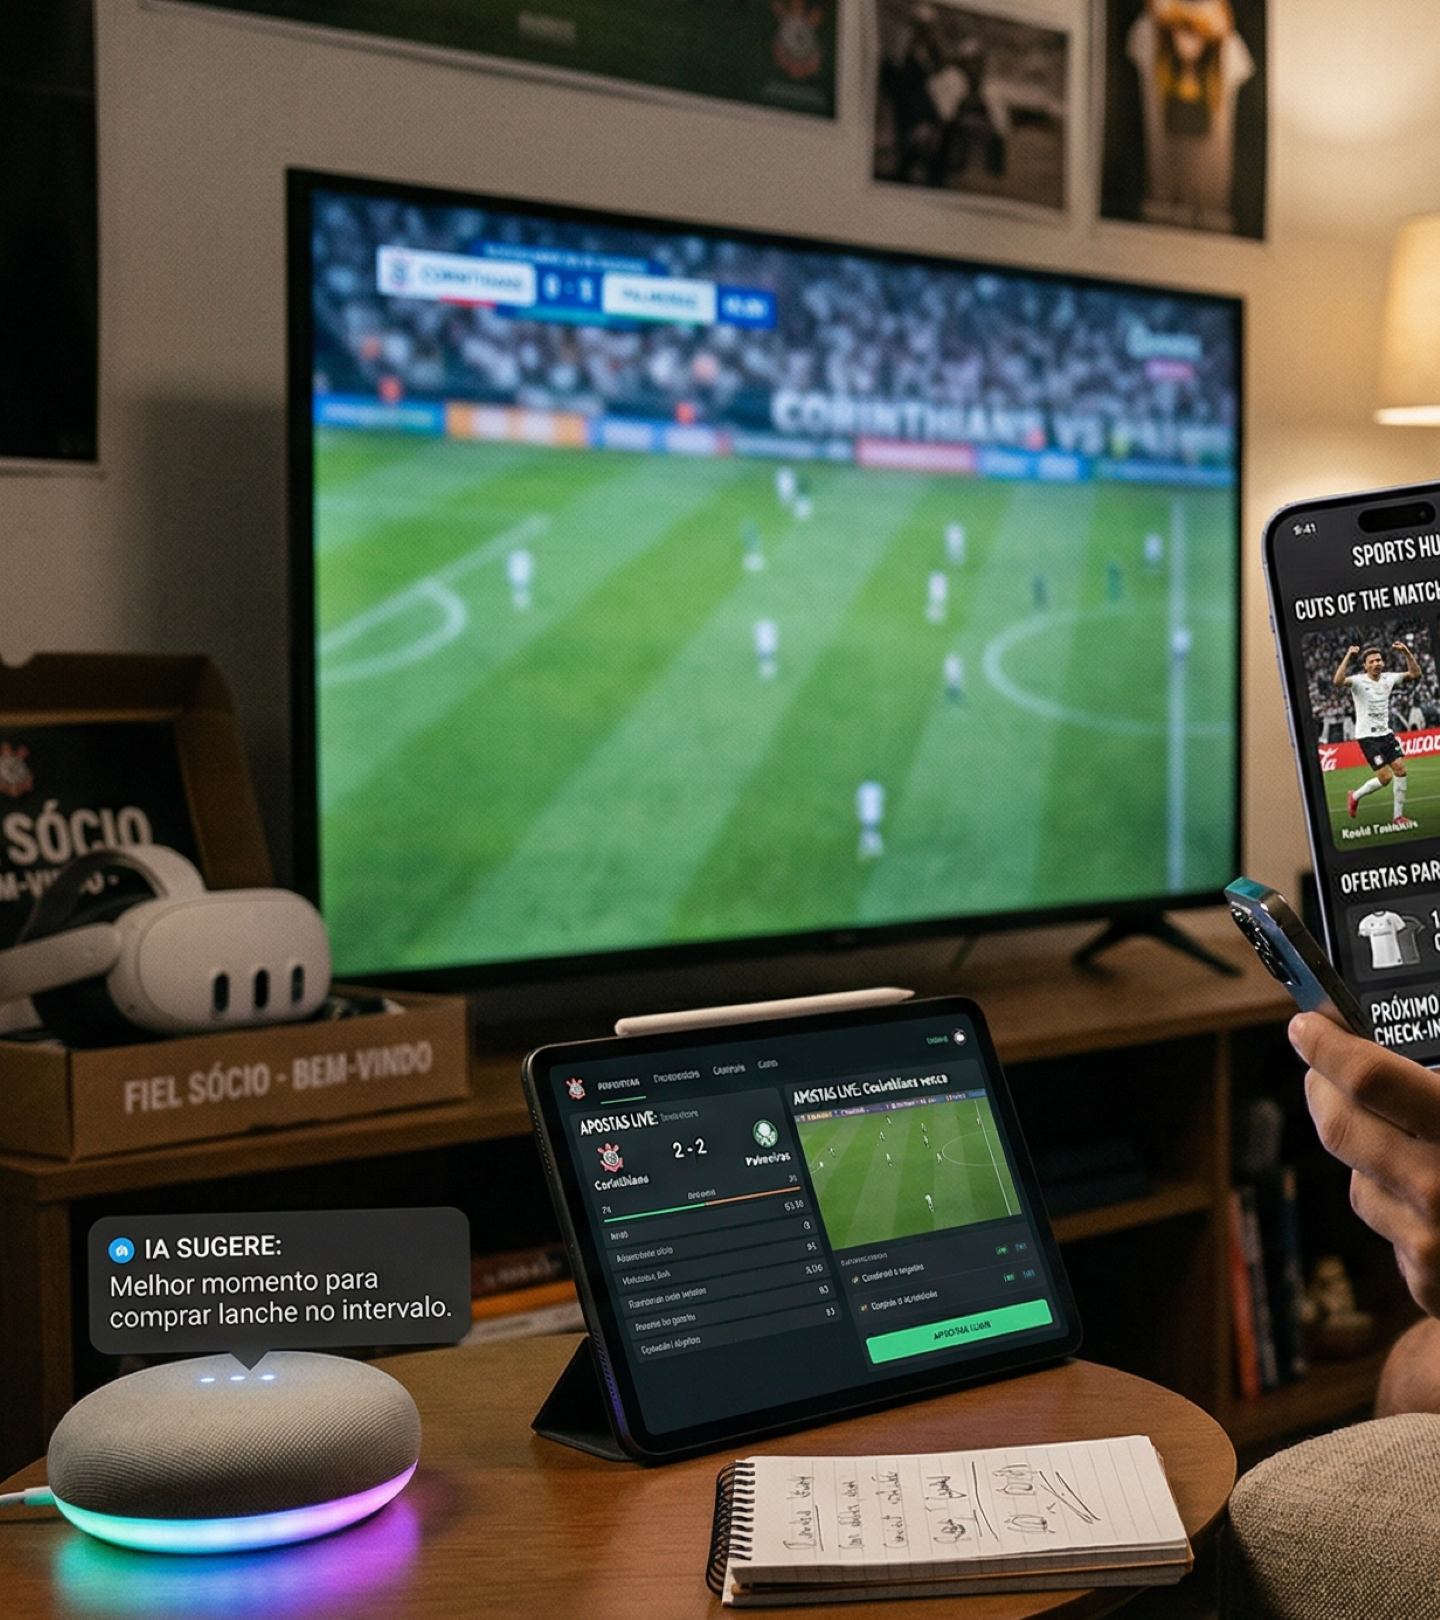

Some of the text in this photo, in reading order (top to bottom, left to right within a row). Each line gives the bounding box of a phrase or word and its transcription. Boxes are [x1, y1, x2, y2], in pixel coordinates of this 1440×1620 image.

[1351, 537, 1417, 568] SPORTS
[1295, 595, 1336, 621] CUTS
[1337, 591, 1357, 615] OF
[1359, 586, 1390, 611] THE
[1340, 864, 1409, 895] OFERTAS
[1370, 994, 1440, 1025] PRÓXIMO
[123, 1074, 184, 1115] FIEL
[187, 1060, 272, 1105] SÓCIO
[291, 1040, 434, 1092] BEM-VINDO
[580, 1115, 631, 1137] APOSTAS
[630, 1110, 660, 1129] LIVE:
[672, 1141, 685, 1159] 2
[694, 1137, 708, 1155] 2
